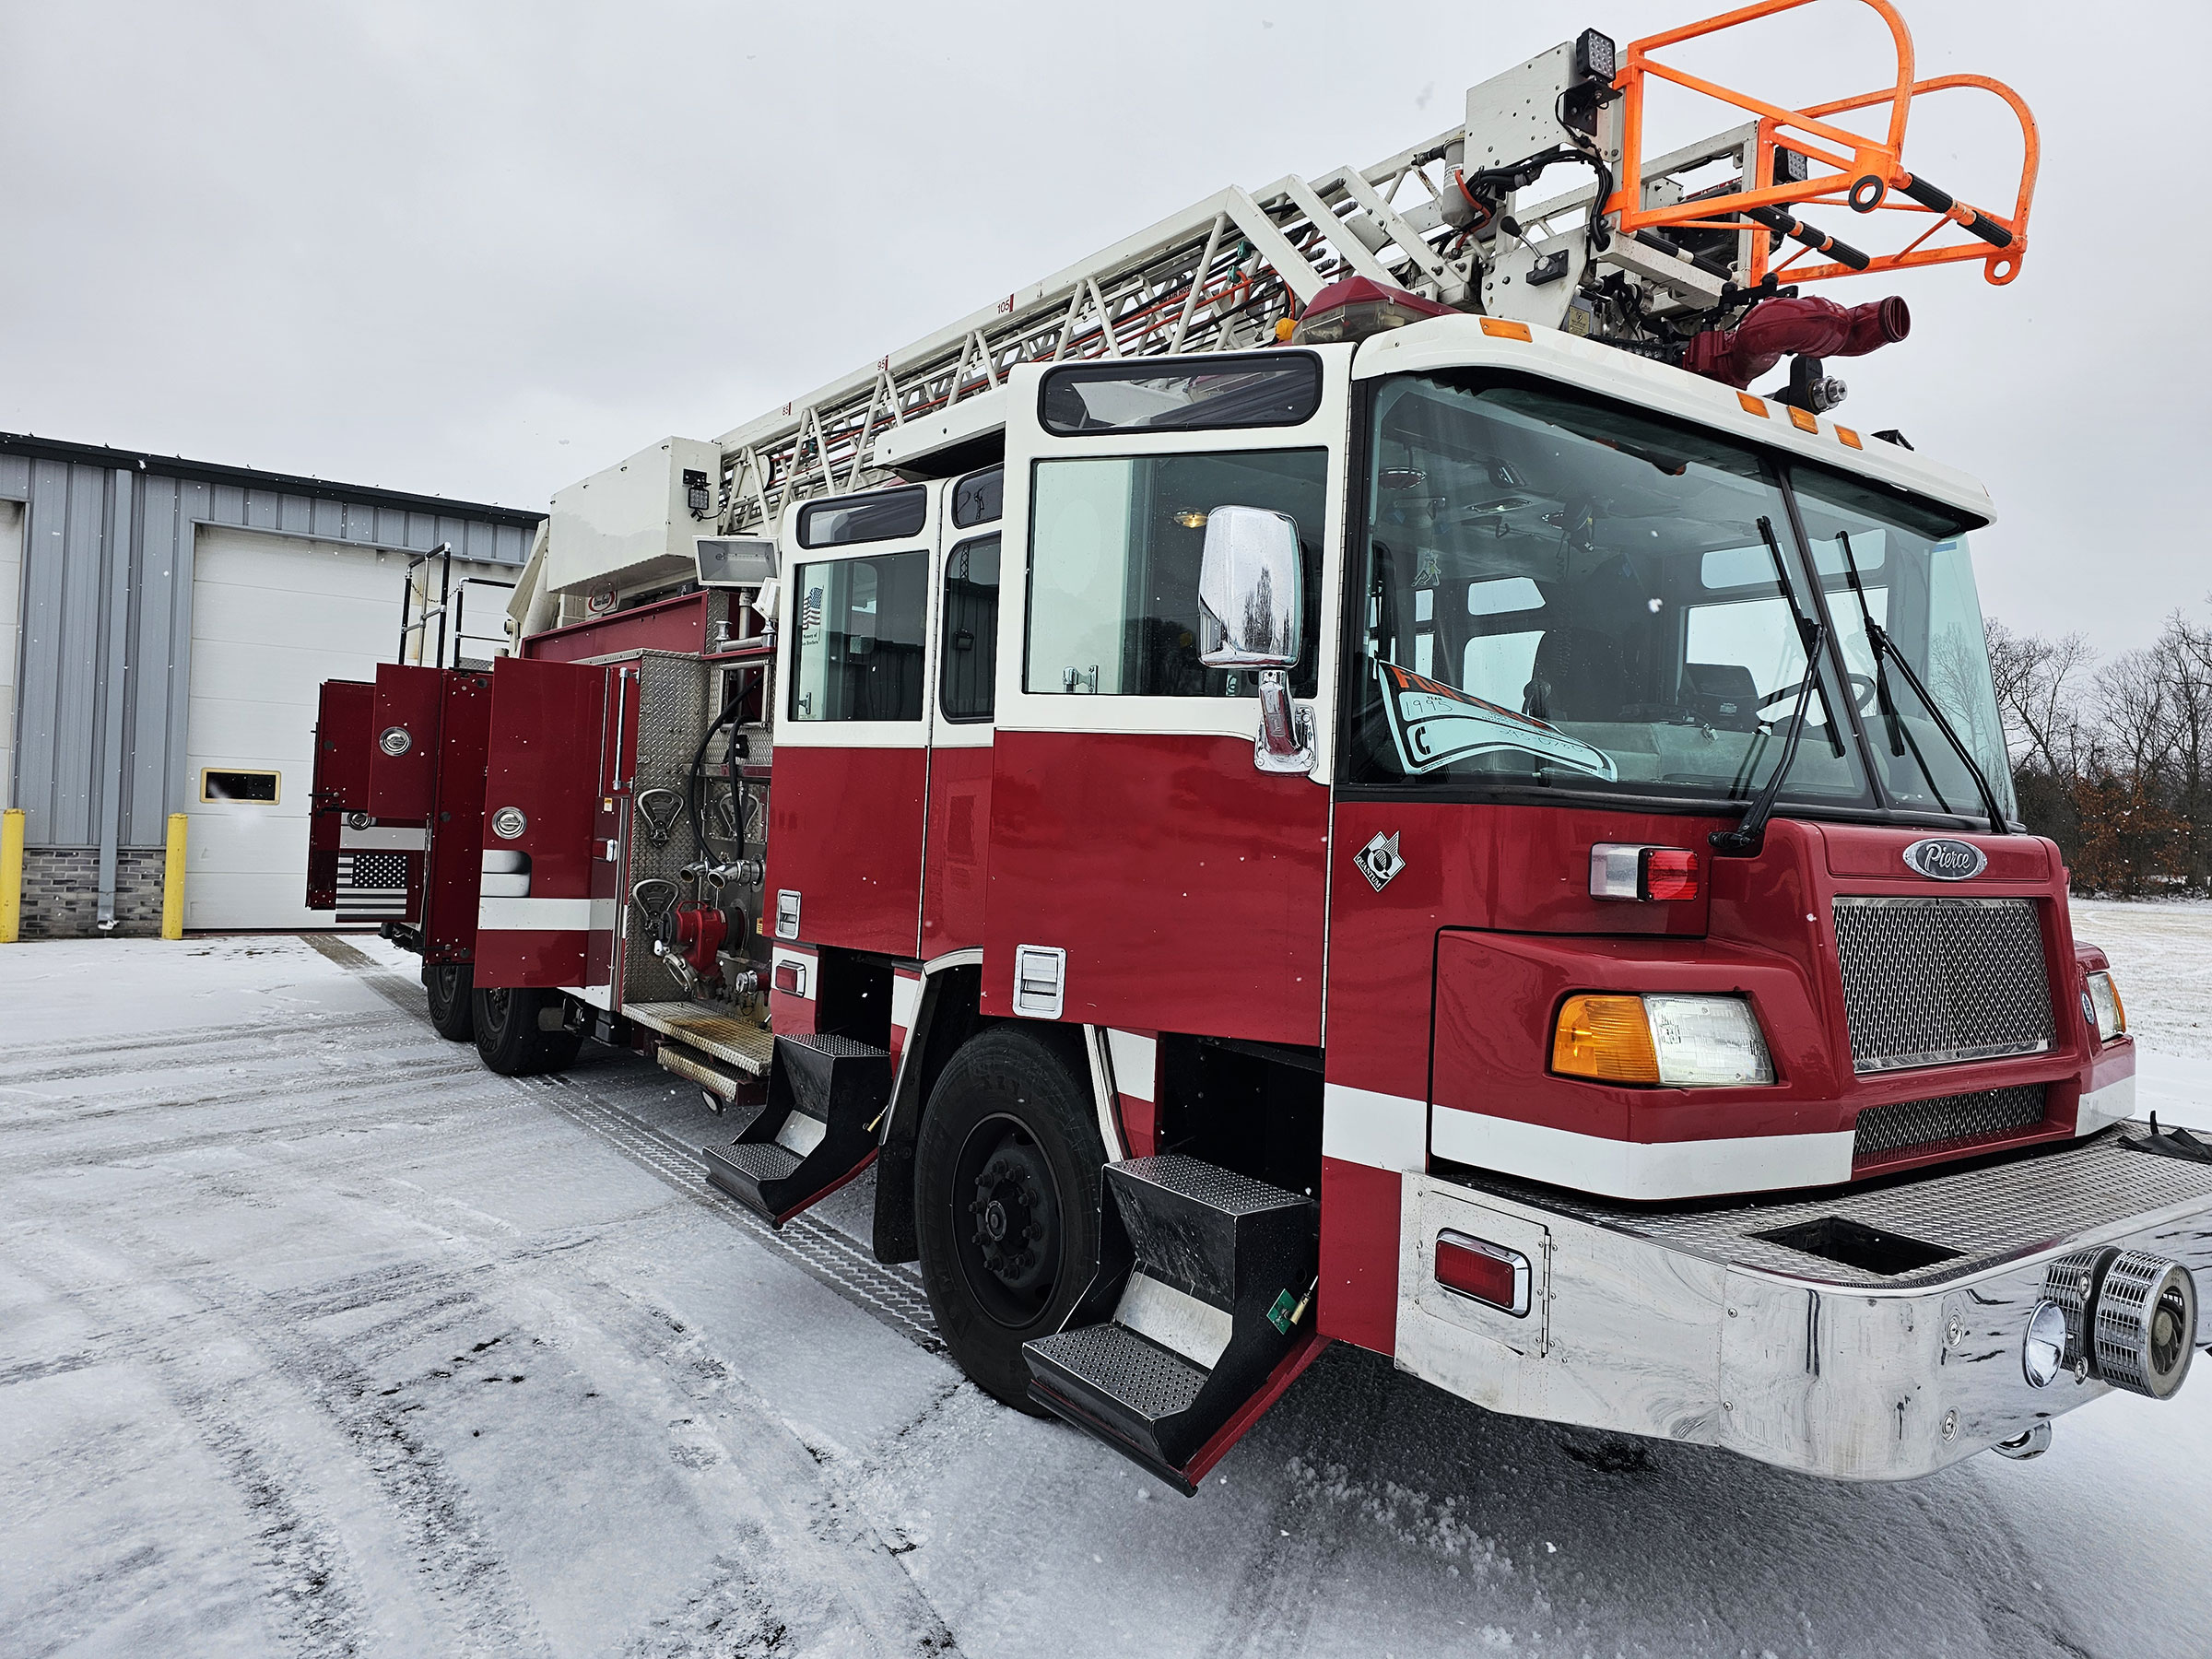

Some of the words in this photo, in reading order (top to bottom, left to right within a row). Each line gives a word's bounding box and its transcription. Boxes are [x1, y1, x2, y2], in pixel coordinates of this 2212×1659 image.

[1390, 665, 1465, 701] FOR
[1406, 700, 1453, 716] 1995
[1357, 856, 1381, 888] QUANTUM
[1924, 843, 1971, 871] Pierce
